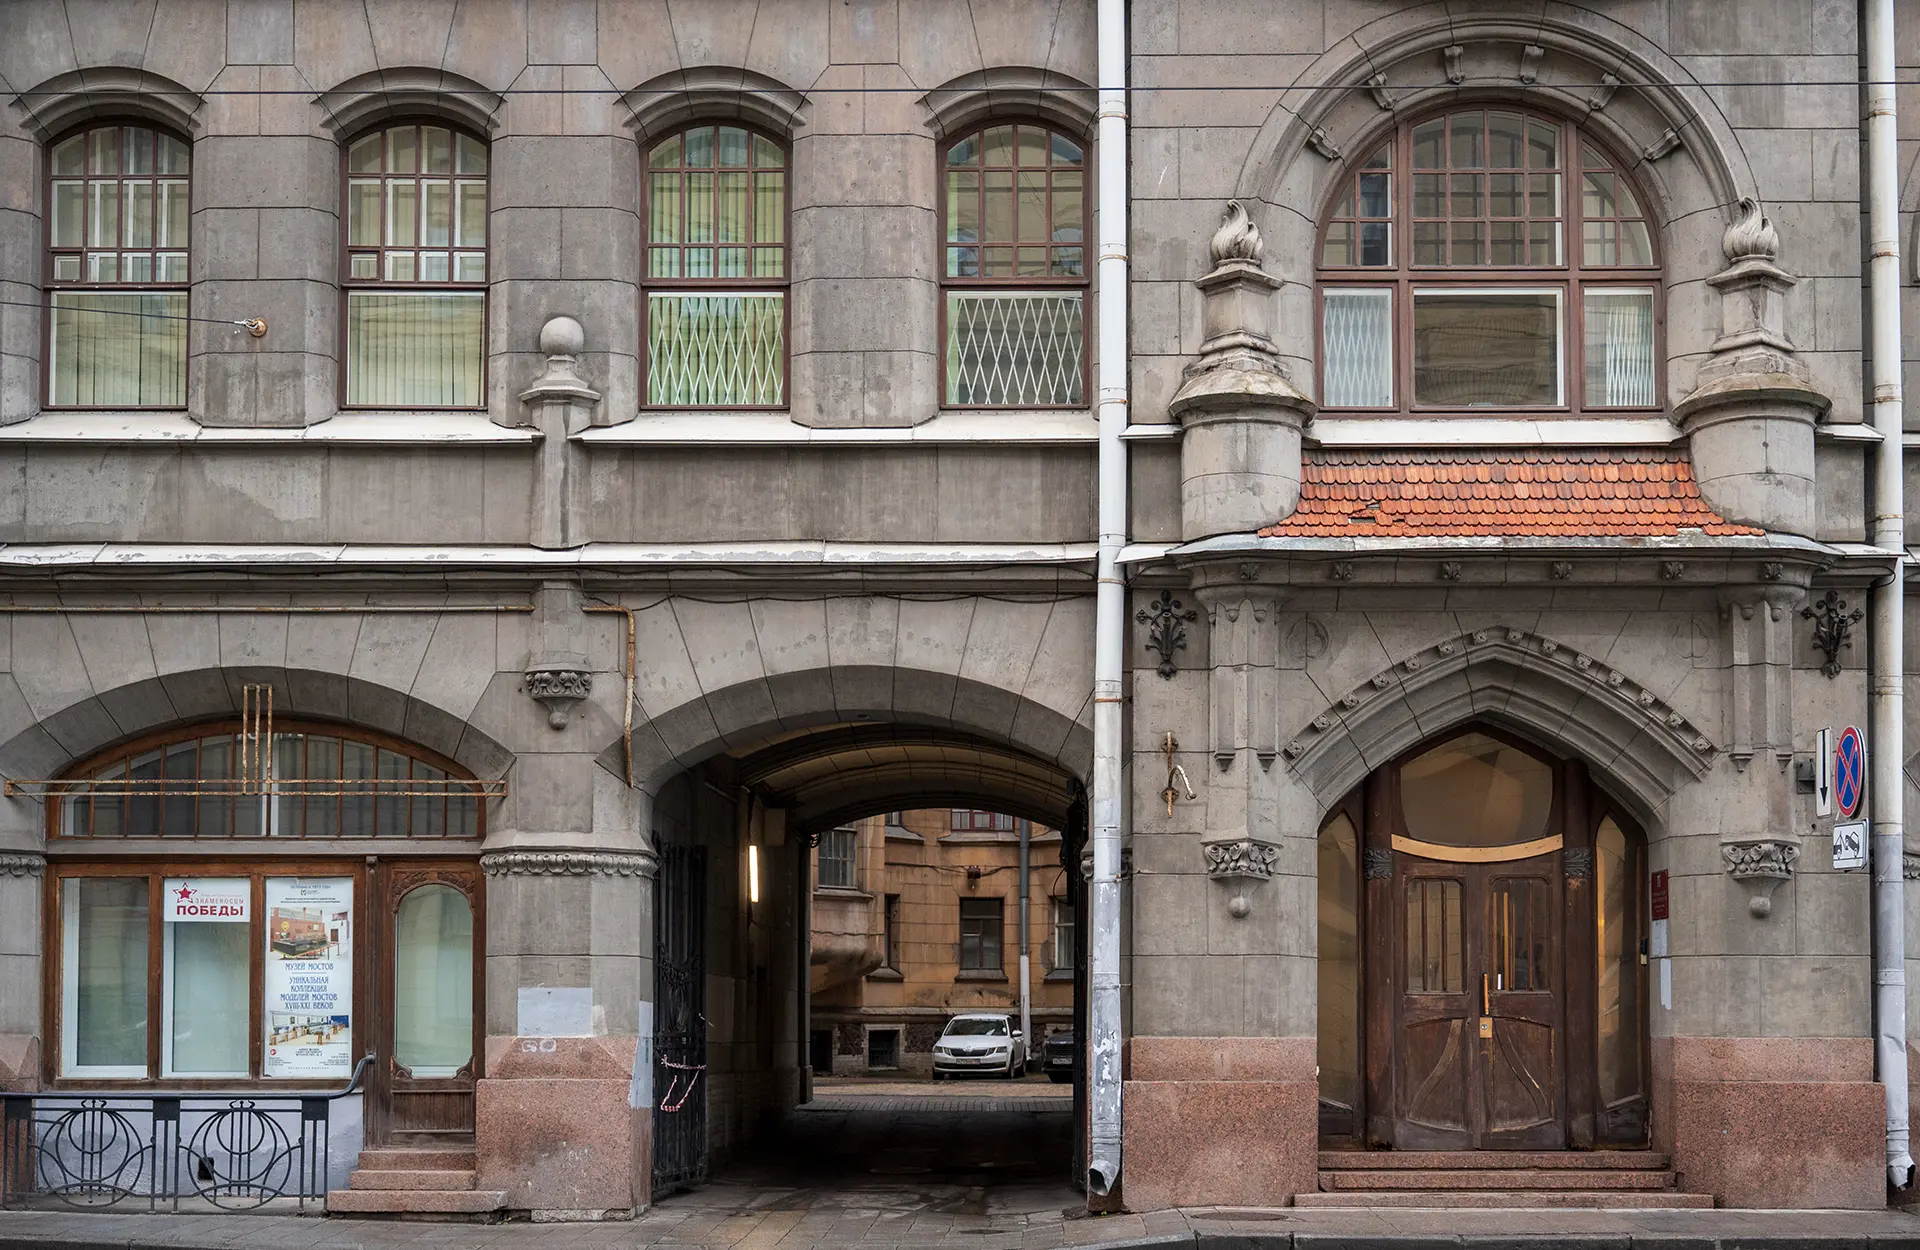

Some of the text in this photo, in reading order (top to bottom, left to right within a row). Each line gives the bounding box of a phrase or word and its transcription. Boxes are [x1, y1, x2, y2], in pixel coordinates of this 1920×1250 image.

[177, 905, 243, 916] ПОБЕДЫ
[285, 962, 306, 970] МУЗЕЙ
[289, 976, 329, 984] УНИКАЛЬНАЯ
[280, 993, 338, 1001] МОДЕЛЕЙ МОСТОВ
